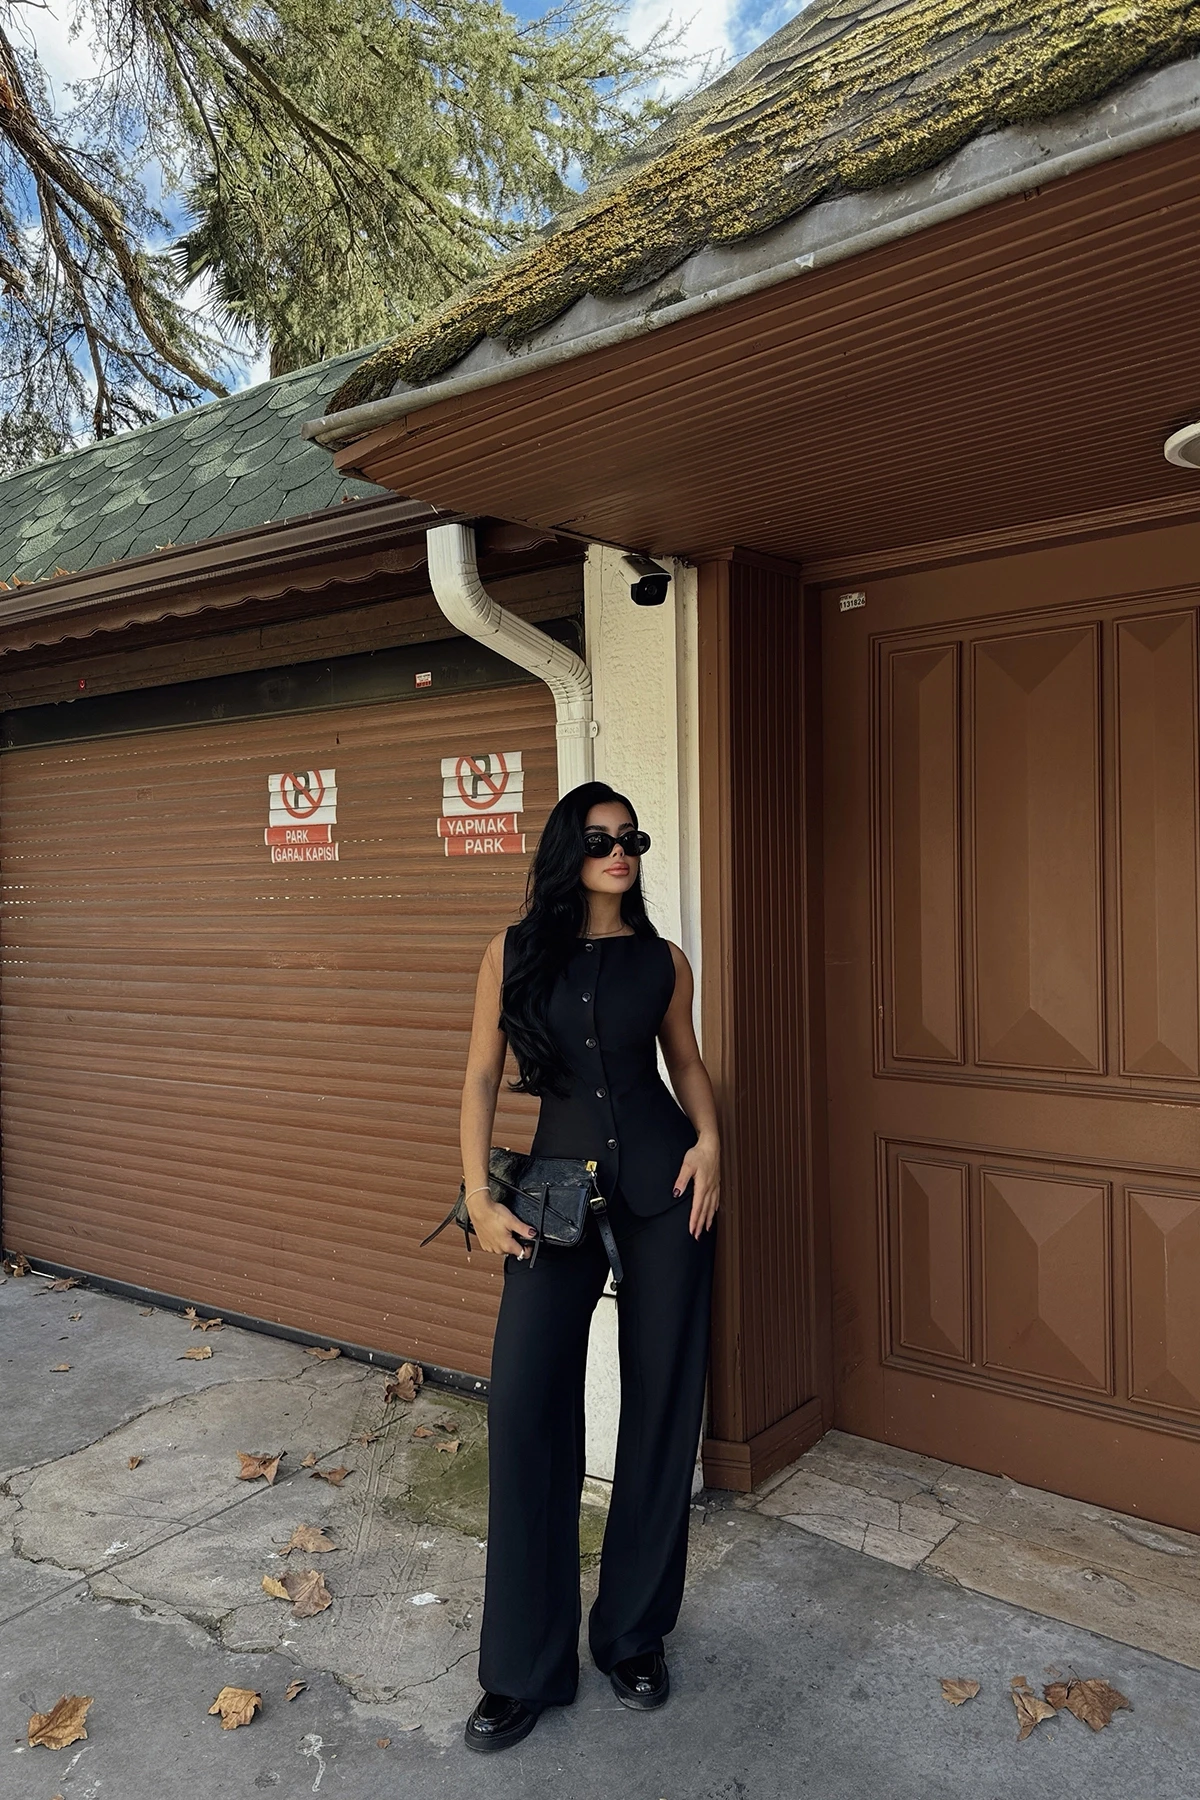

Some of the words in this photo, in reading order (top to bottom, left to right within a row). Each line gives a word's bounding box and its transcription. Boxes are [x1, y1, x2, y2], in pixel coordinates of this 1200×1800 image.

[446, 817, 508, 836] YAPMAK
[285, 829, 310, 844] PARK
[275, 847, 304, 862] GARAJ
[305, 846, 335, 862] KAPISI
[464, 837, 505, 855] PARK
